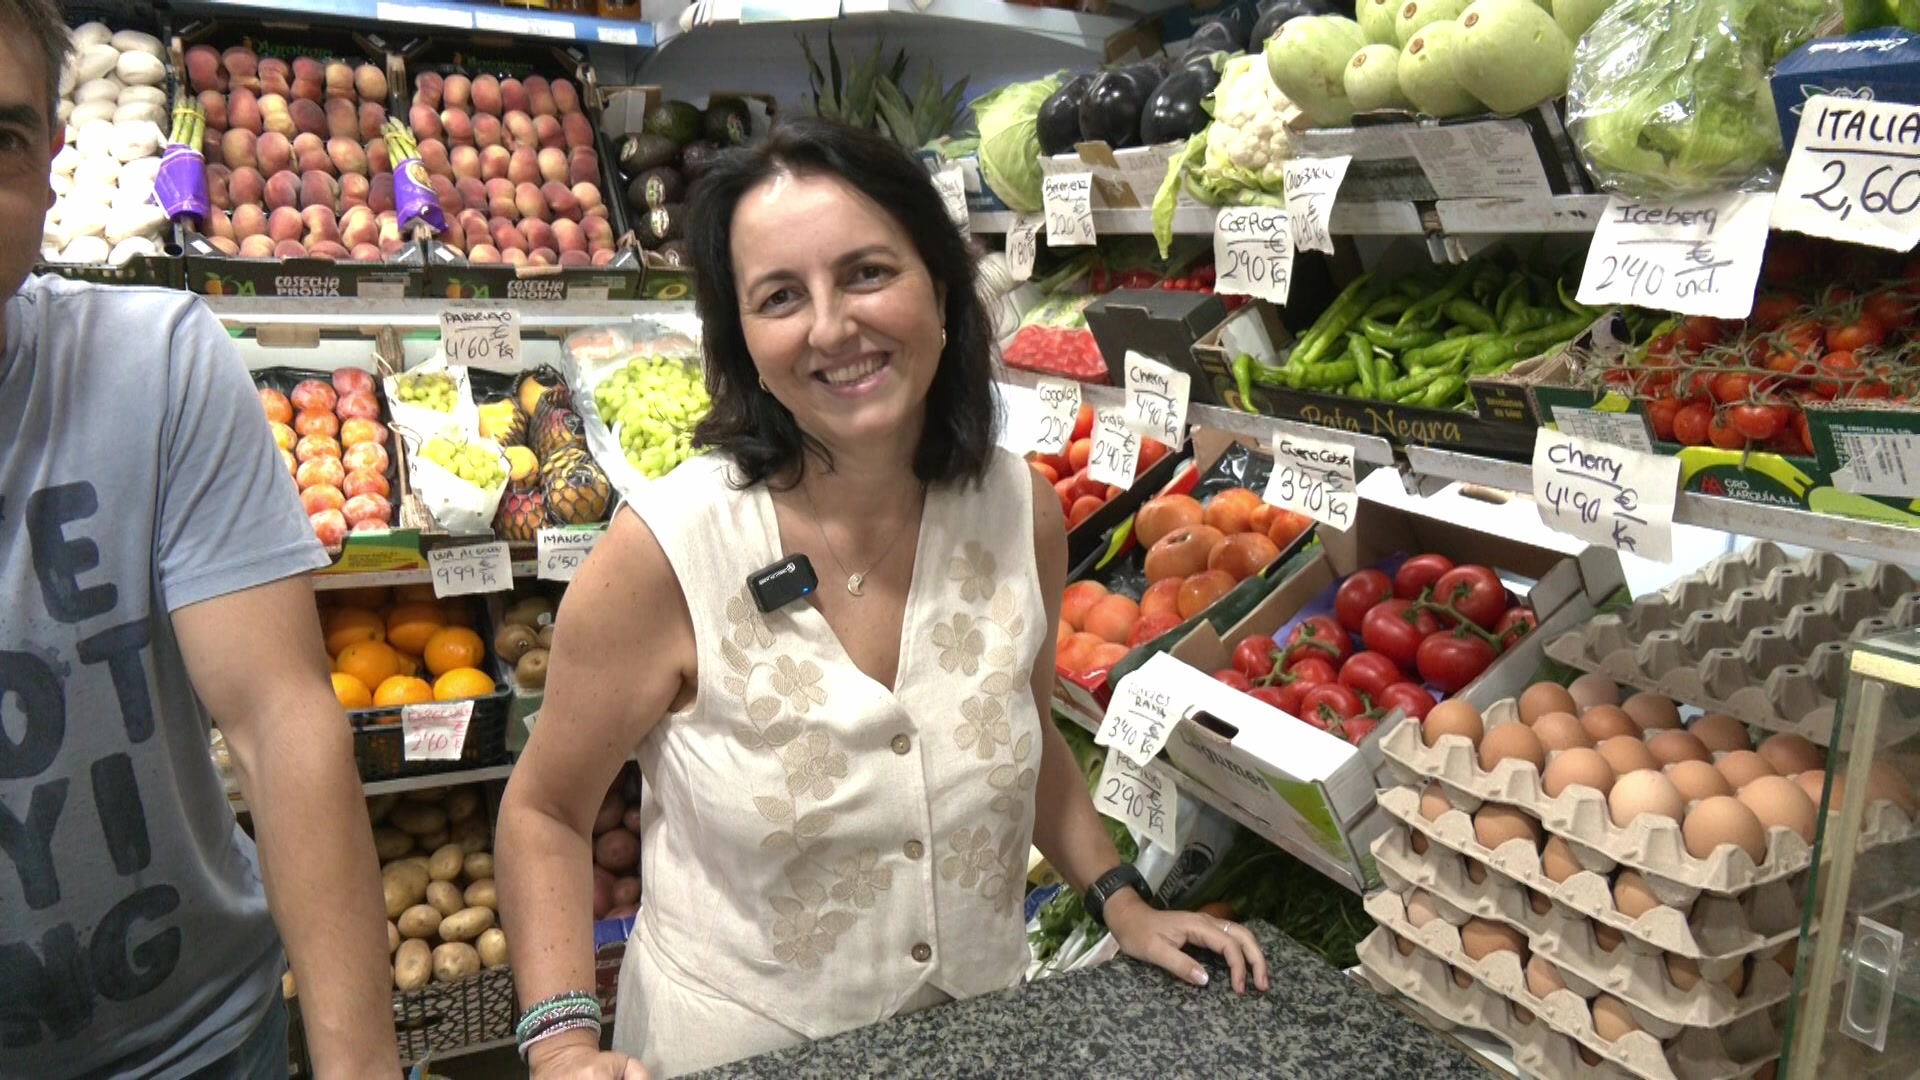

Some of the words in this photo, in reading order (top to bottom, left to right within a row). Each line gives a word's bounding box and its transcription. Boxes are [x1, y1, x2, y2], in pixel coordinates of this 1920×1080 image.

[1800, 160, 1920, 221] 2,60
[1613, 204, 1718, 235] Iceberg
[274, 275, 341, 287] COSECHA
[507, 279, 565, 290] COSECHA
[1596, 254, 1665, 297] 2'40
[276, 287, 341, 297] PROPIA
[507, 289, 564, 300] PROPIA
[1300, 404, 1361, 433] Pata
[1363, 407, 1462, 448] Negra
[1547, 442, 1623, 482] Cherry
[0, 480, 118, 623] E
[543, 532, 593, 544] MANGO
